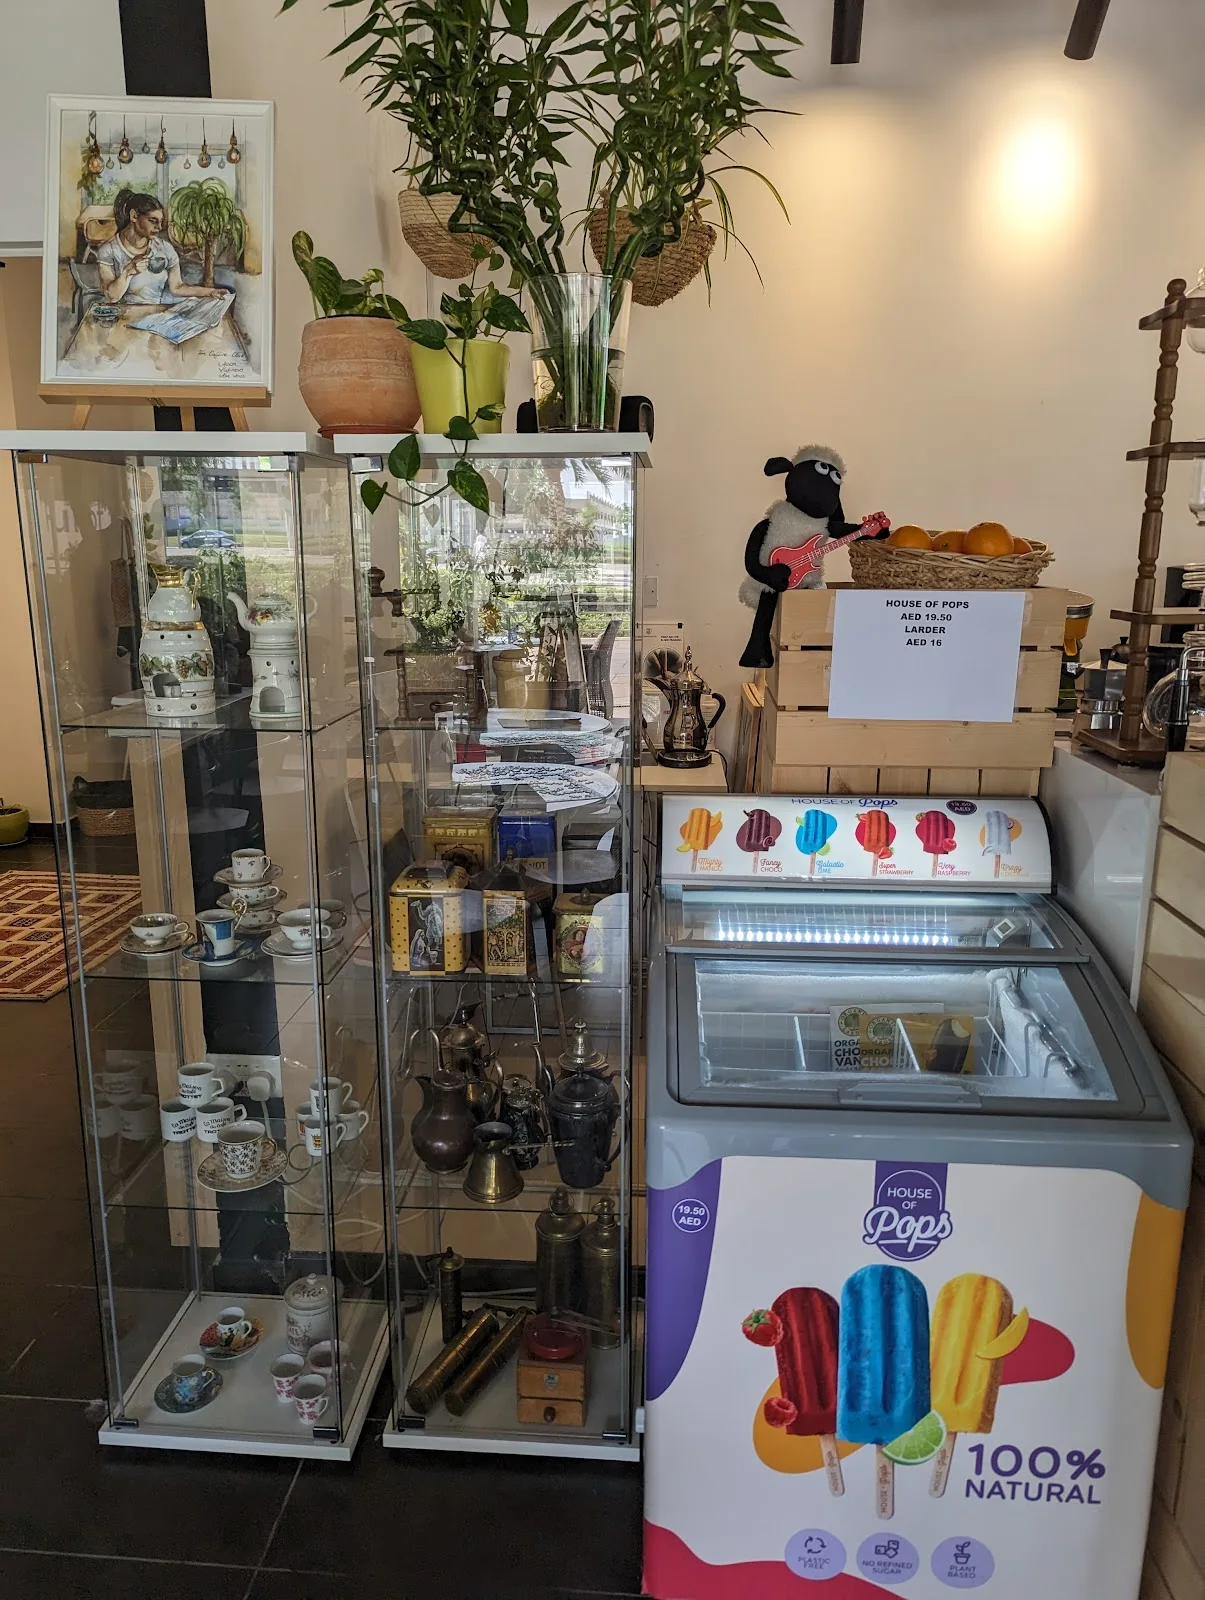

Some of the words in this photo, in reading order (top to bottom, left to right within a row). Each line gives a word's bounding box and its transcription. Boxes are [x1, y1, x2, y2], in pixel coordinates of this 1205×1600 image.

[886, 600, 922, 608] HOUSE
[925, 600, 939, 608] OF
[942, 601, 970, 609] POPS
[900, 613, 921, 621] AED
[925, 613, 952, 621] 19.50
[905, 626, 946, 634] LARDER
[906, 638, 927, 646] AED
[930, 639, 942, 647] 16
[858, 798, 898, 809] Pops
[760, 858, 782, 868] Fancy
[816, 860, 844, 869] Galactic
[878, 862, 896, 871] Super
[937, 862, 956, 872] Very
[834, 1039, 861, 1047] ORGA
[834, 1047, 860, 1057] CHO
[834, 1056, 861, 1067] VAN
[887, 1187, 933, 1199] HOUSE
[901, 1200, 918, 1210] OF
[677, 1205, 706, 1216] 19.50
[678, 1216, 702, 1226] AED
[863, 1205, 953, 1253] Pops
[967, 1443, 1106, 1480] 100%
[965, 1479, 1102, 1504] NATURAL
[880, 1490, 889, 1513] HOUSE
[797, 1556, 830, 1565] PLASTIC
[803, 1562, 825, 1570] FREE
[876, 1561, 913, 1570] REFINED
[949, 1564, 976, 1572] PLANT
[872, 1567, 902, 1575] SUGAR
[947, 1571, 976, 1579] BASED
